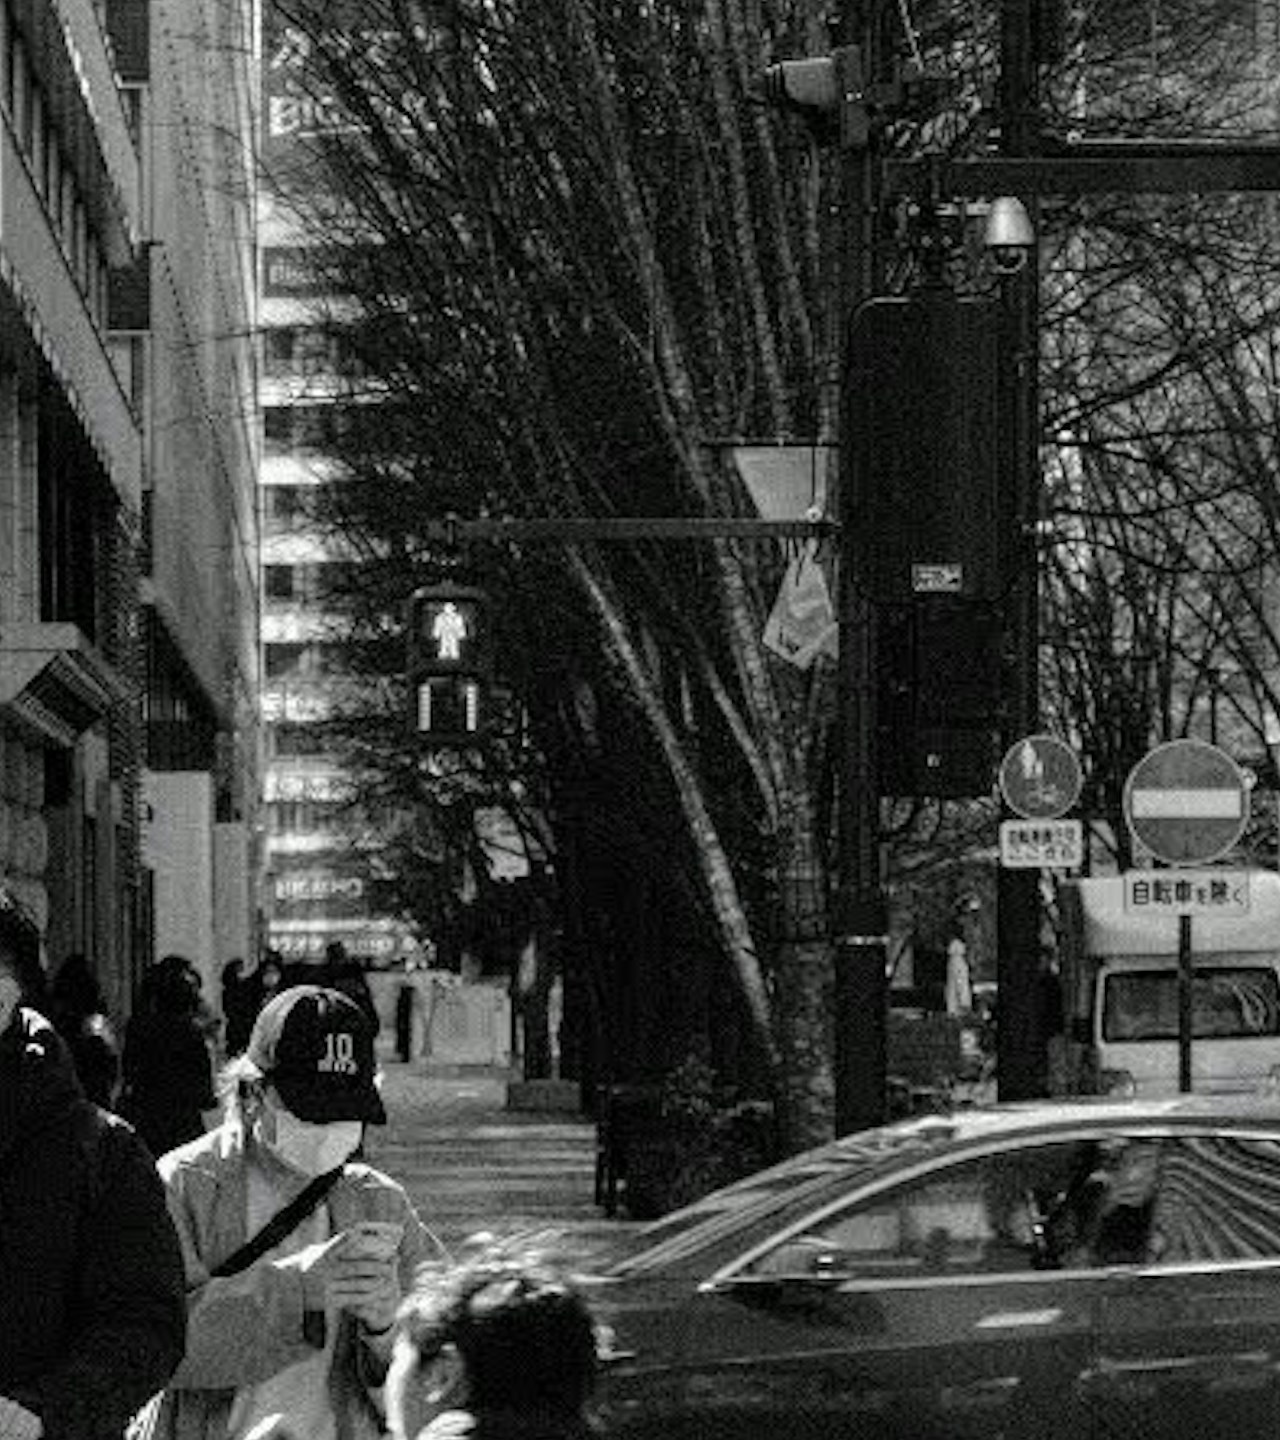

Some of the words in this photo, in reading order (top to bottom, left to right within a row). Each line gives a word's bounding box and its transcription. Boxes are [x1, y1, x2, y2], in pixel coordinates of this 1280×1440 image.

[1132, 879, 1244, 906] 自転車を除く
